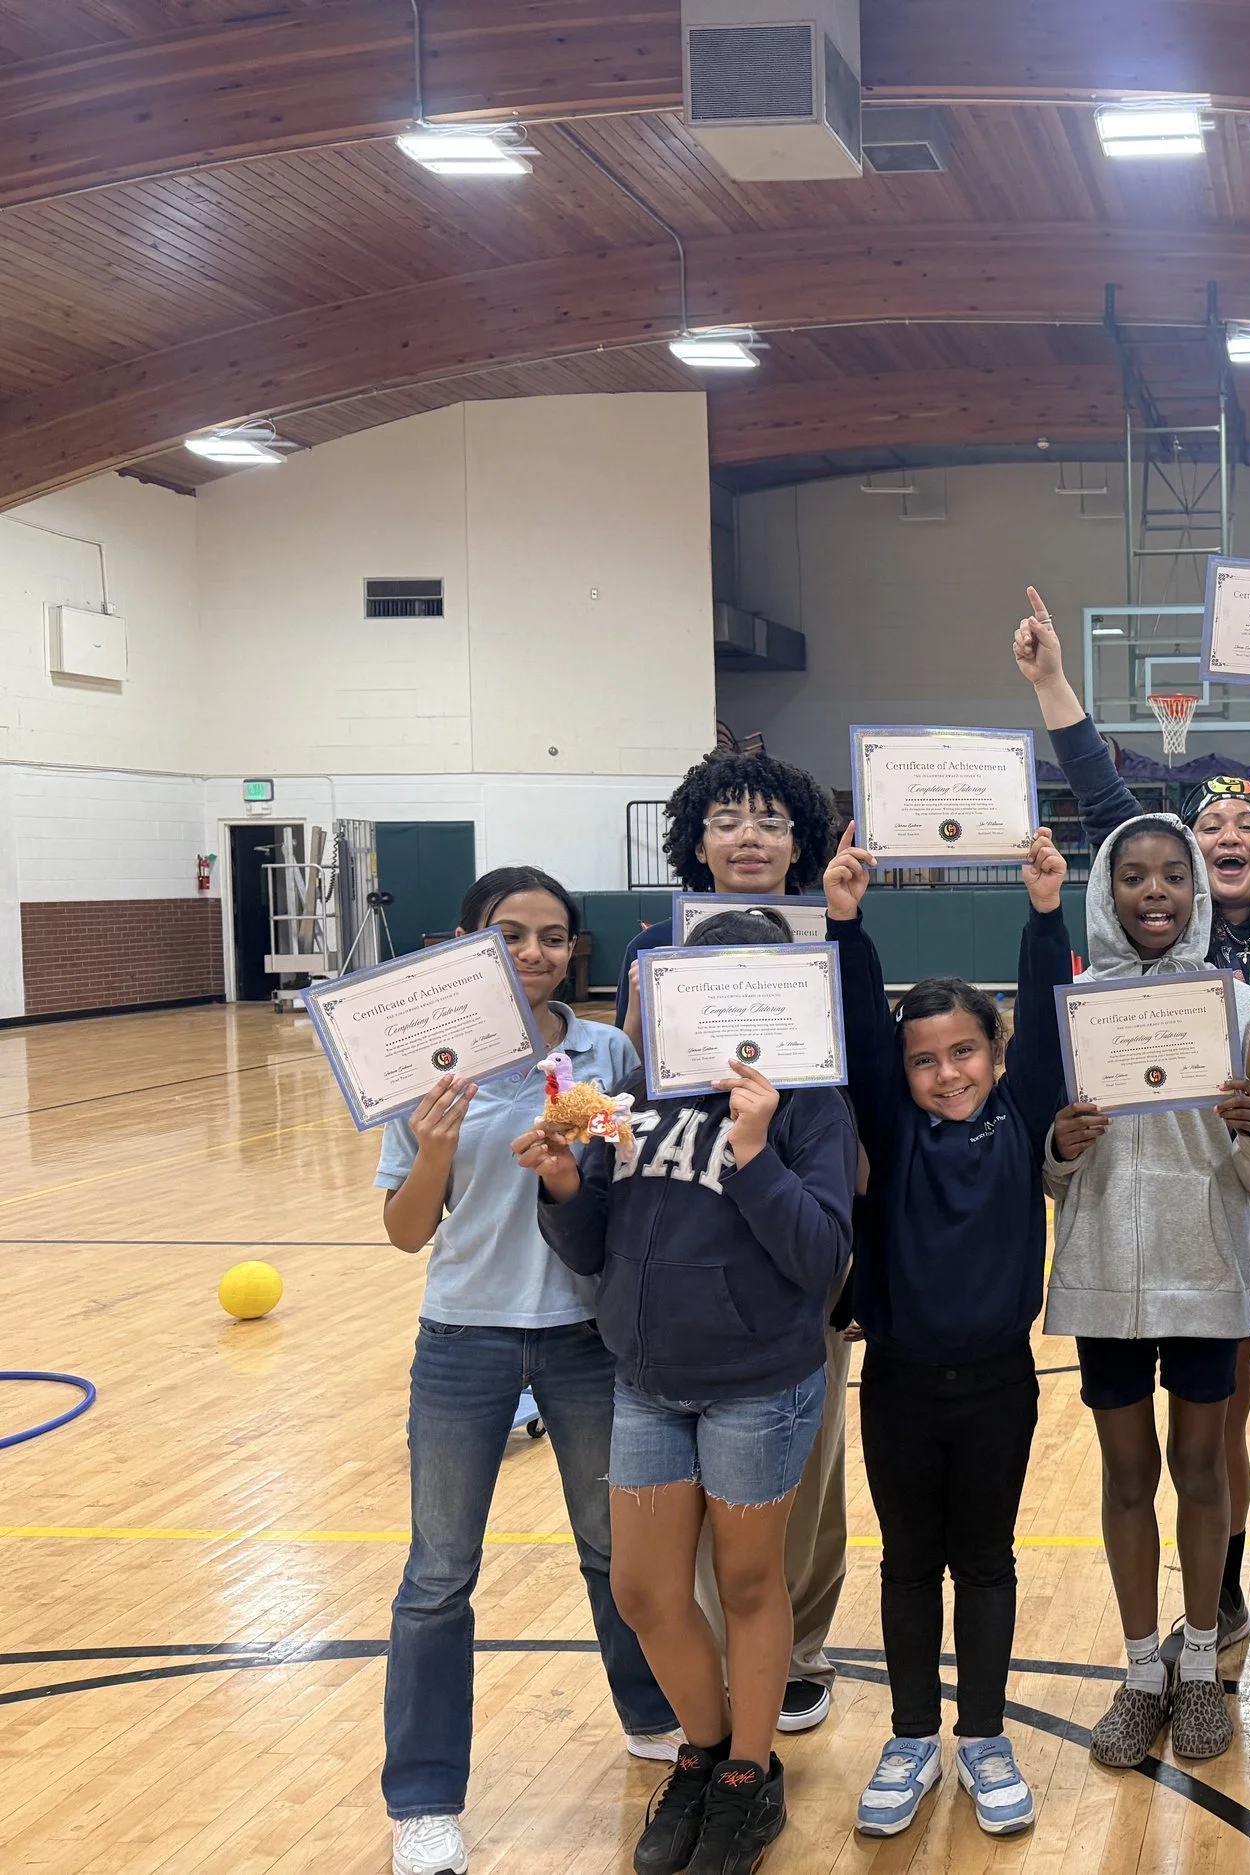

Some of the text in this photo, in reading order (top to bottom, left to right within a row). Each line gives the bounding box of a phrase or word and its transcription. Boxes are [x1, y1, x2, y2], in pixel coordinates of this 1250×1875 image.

[886, 761, 1005, 770] Certificate of Achievement
[907, 783, 986, 795] Completing Tutoring
[677, 980, 807, 991] Certificate of Achievement
[352, 971, 482, 1021] Certificate of Achievement
[701, 1003, 785, 1016] Completing Tutoring
[1090, 1006, 1205, 1025] Certificate of Achievement
[384, 1003, 468, 1036] Completing Tutoring
[1112, 1030, 1187, 1045] Completing Tutoring
